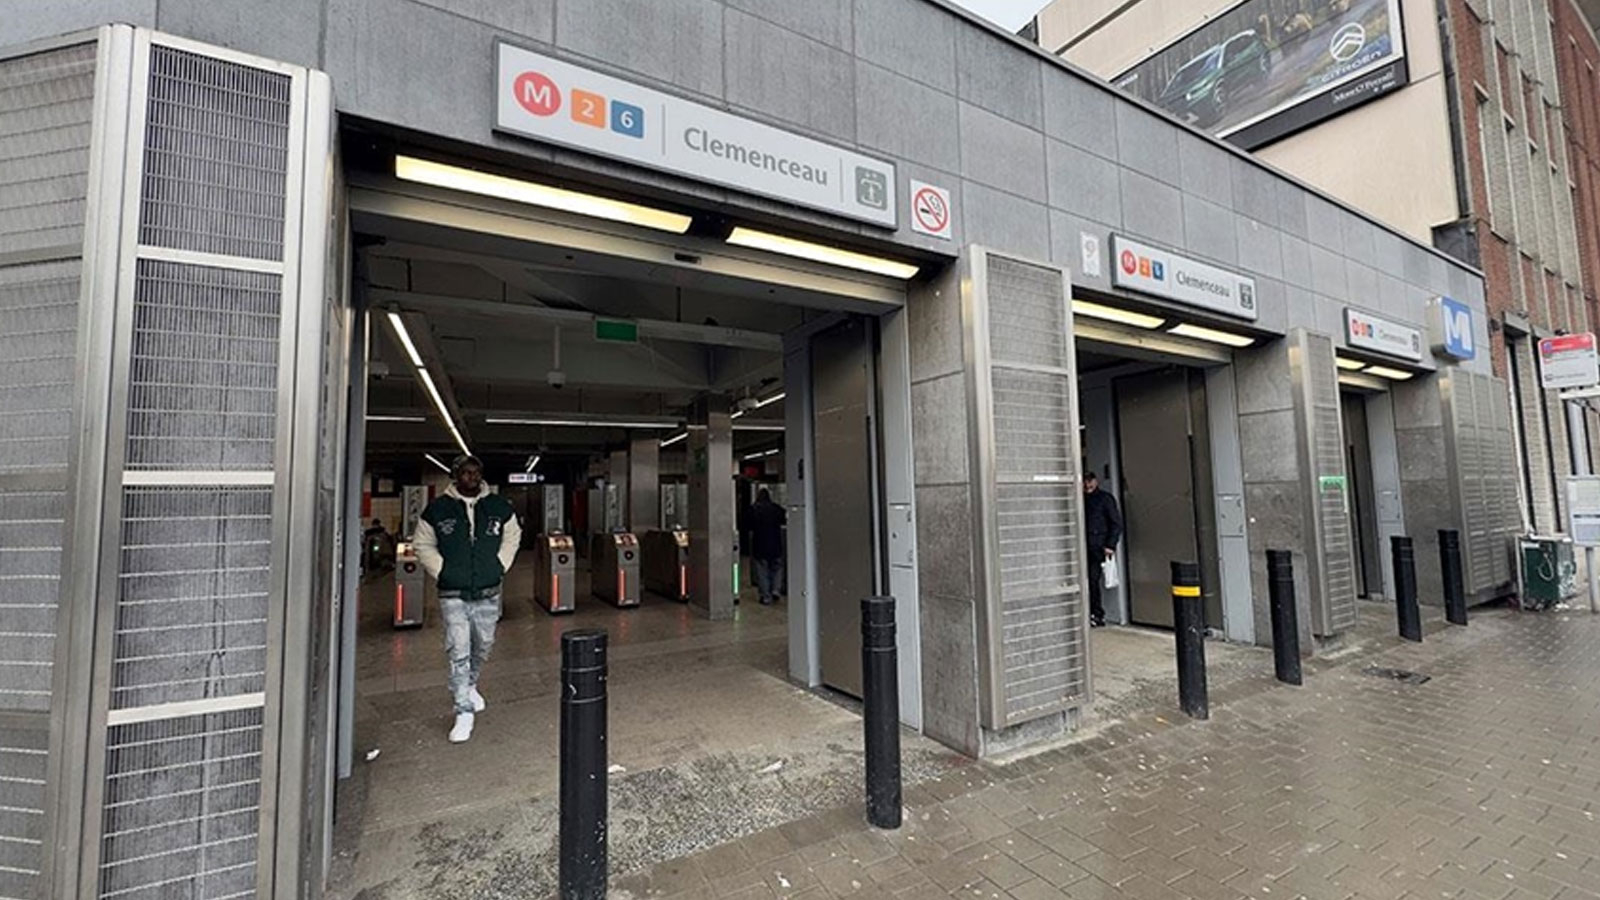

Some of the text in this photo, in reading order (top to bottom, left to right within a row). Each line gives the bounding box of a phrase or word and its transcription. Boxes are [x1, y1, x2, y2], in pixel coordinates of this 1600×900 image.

[523, 80, 828, 187] M 2 6 Clemenceau
[1176, 270, 1230, 298] Clemenceau
[1443, 304, 1473, 353] M
